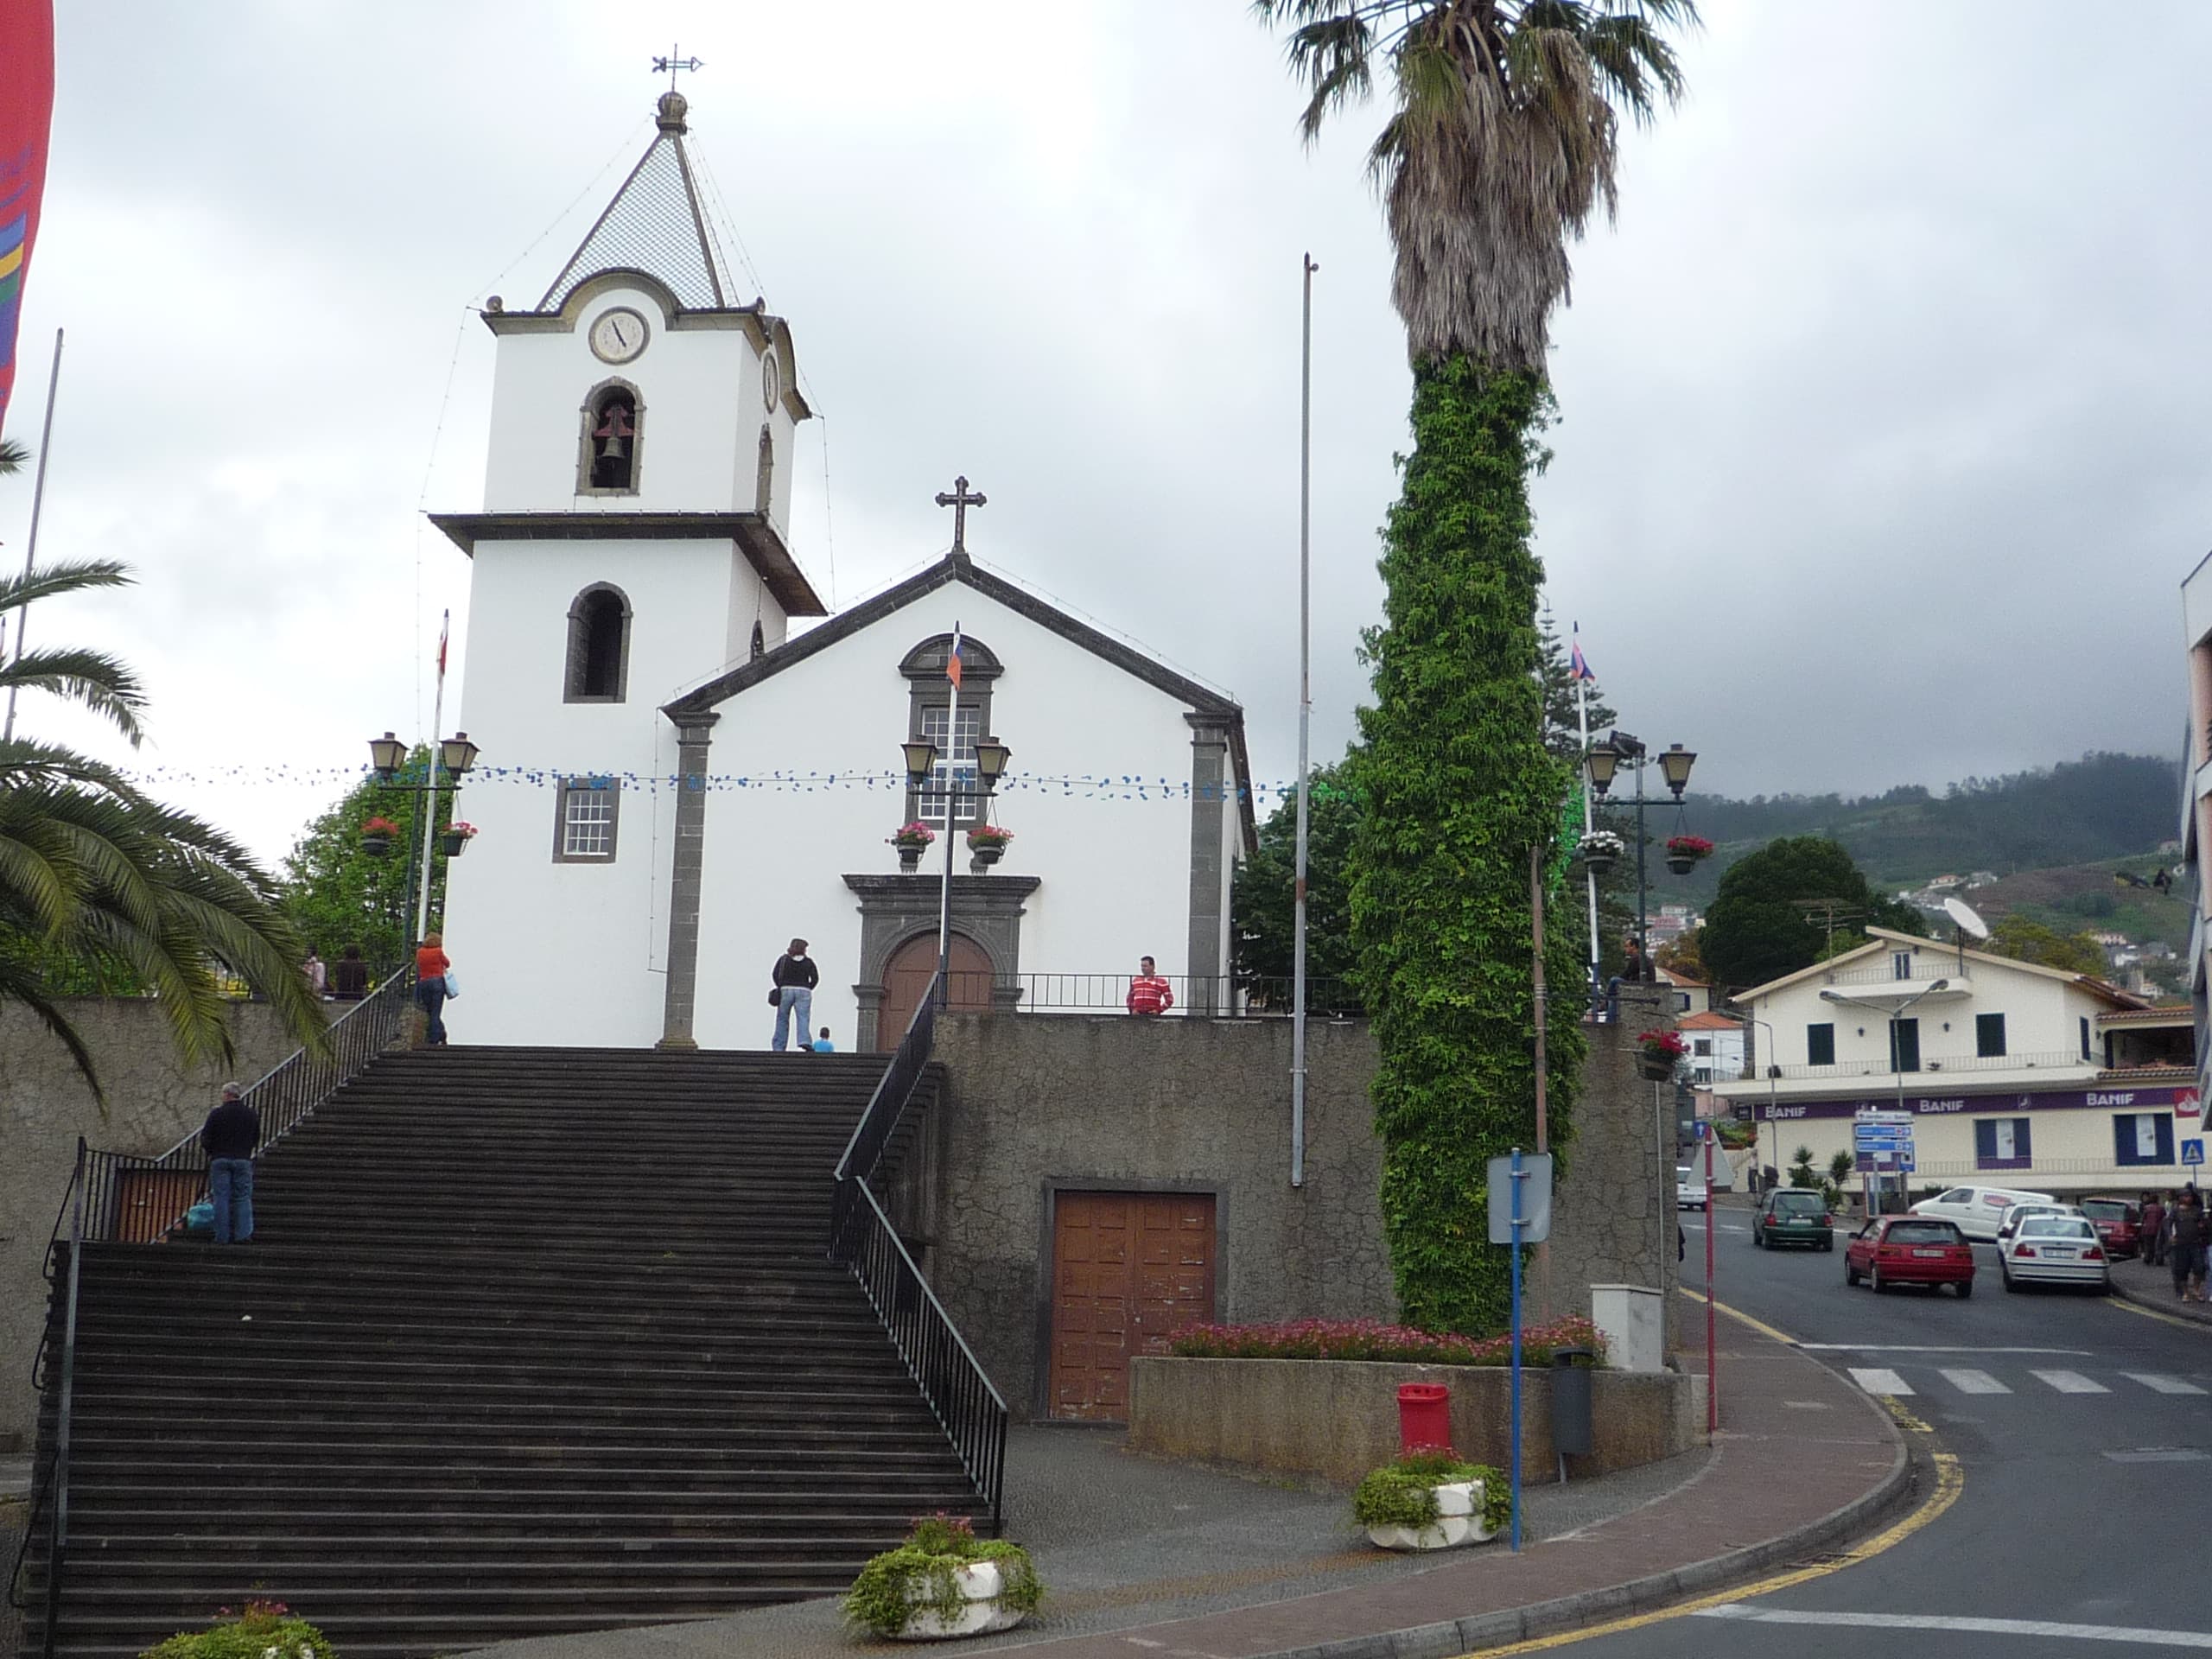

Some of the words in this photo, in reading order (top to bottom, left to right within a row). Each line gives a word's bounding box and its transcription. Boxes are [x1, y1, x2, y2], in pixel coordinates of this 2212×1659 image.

[1919, 1099, 1964, 1112] BANIF
[2086, 1092, 2133, 1106] BANIF
[1765, 1106, 1807, 1118] BANIF
